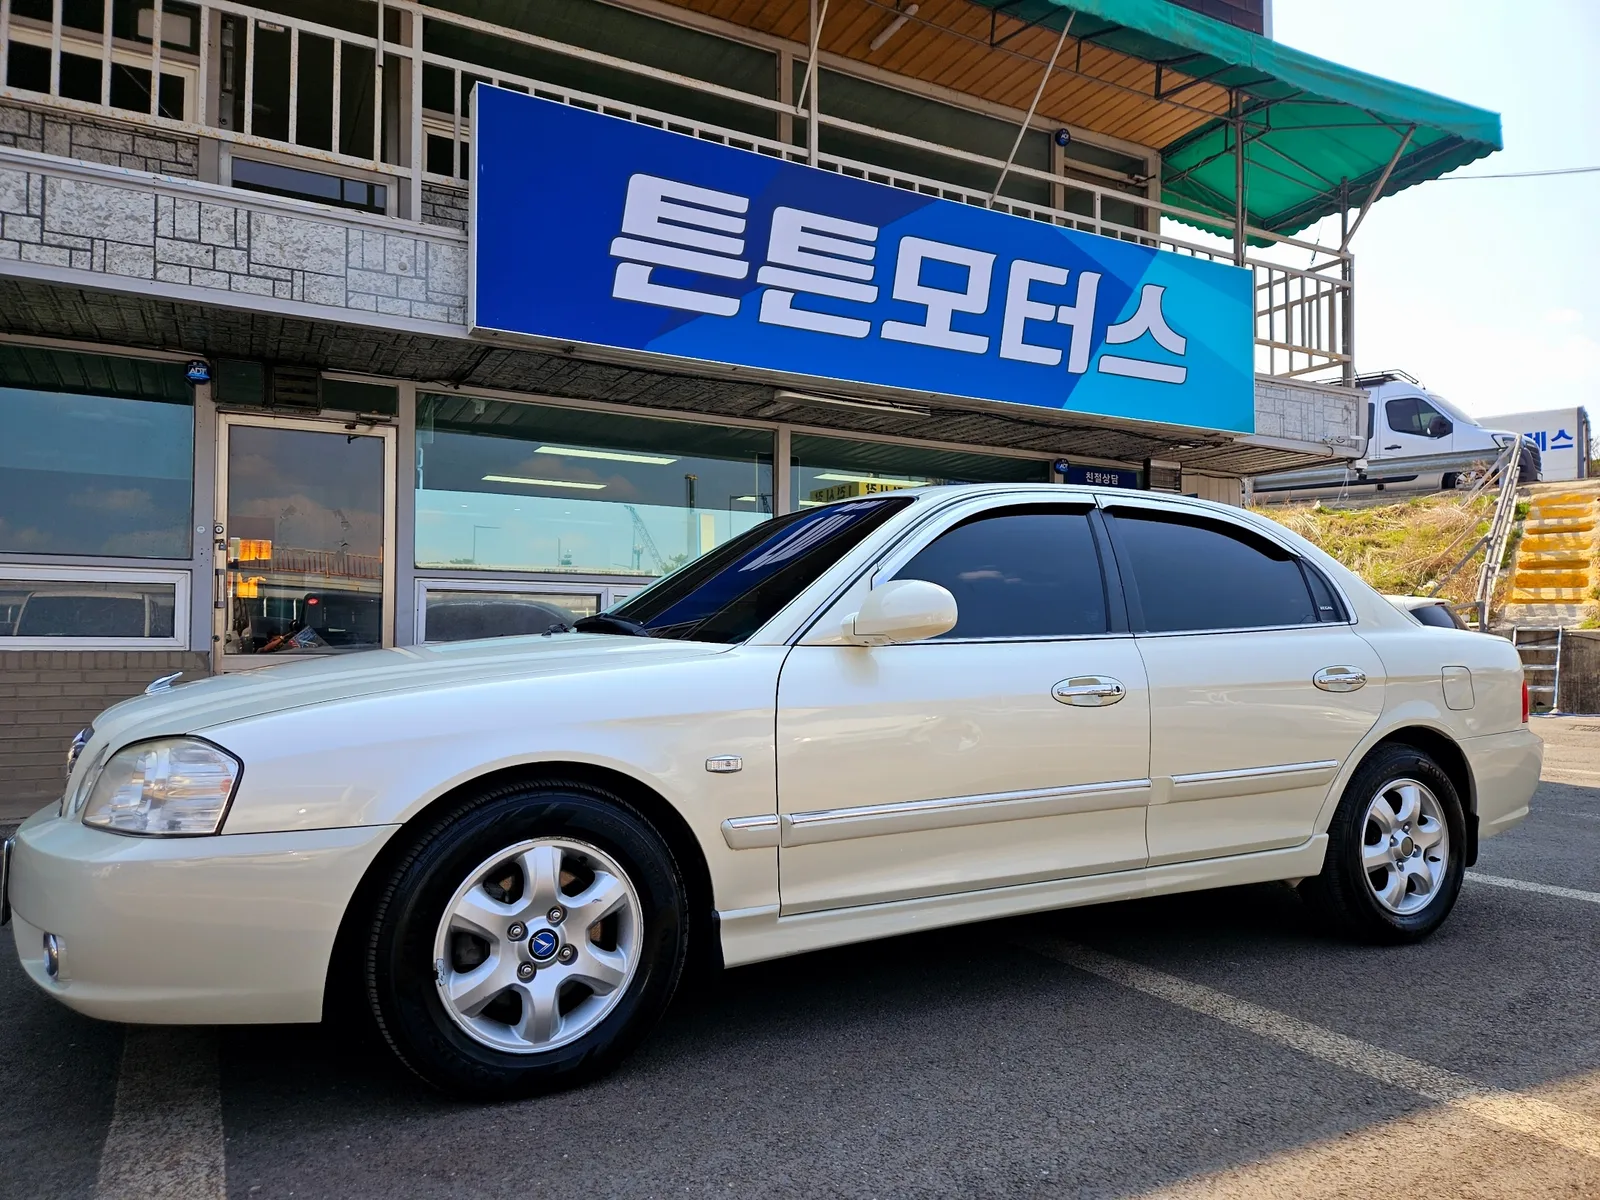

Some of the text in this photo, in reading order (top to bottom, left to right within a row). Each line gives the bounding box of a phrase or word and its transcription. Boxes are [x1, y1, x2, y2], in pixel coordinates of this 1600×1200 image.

[609, 172, 1188, 385] 튼튼모터스
[188, 367, 207, 375] ADT
[1085, 471, 1119, 485] 친절상담
